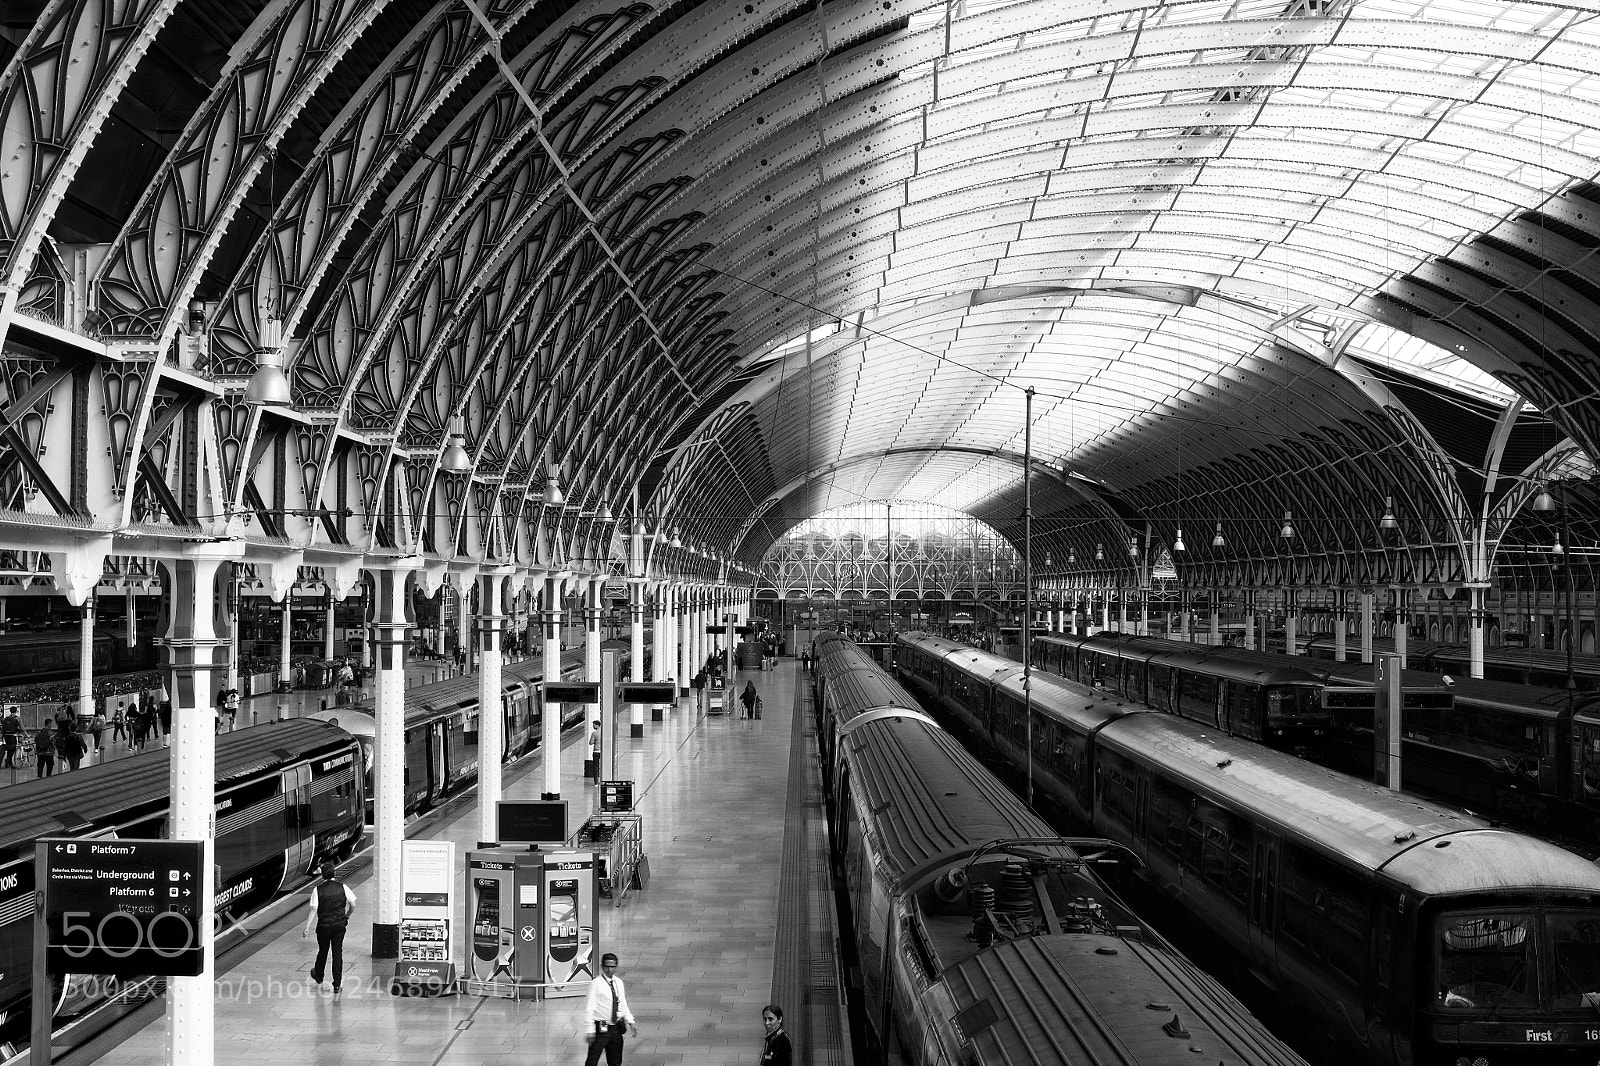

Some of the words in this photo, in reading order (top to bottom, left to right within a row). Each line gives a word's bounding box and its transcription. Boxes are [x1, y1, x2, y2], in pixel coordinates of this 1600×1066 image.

[91, 845, 129, 855] Platform
[130, 846, 136, 855] 7
[480, 861, 503, 870] Tickets
[557, 862, 582, 870] Tickets
[96, 870, 155, 881] Underground
[0, 873, 18, 892] IONS
[233, 877, 253, 898] CLOUDS
[109, 887, 147, 897] Platform
[148, 887, 155, 897] 6
[1526, 1029, 1553, 1042] First
[1584, 1029, 1600, 1041] 16
